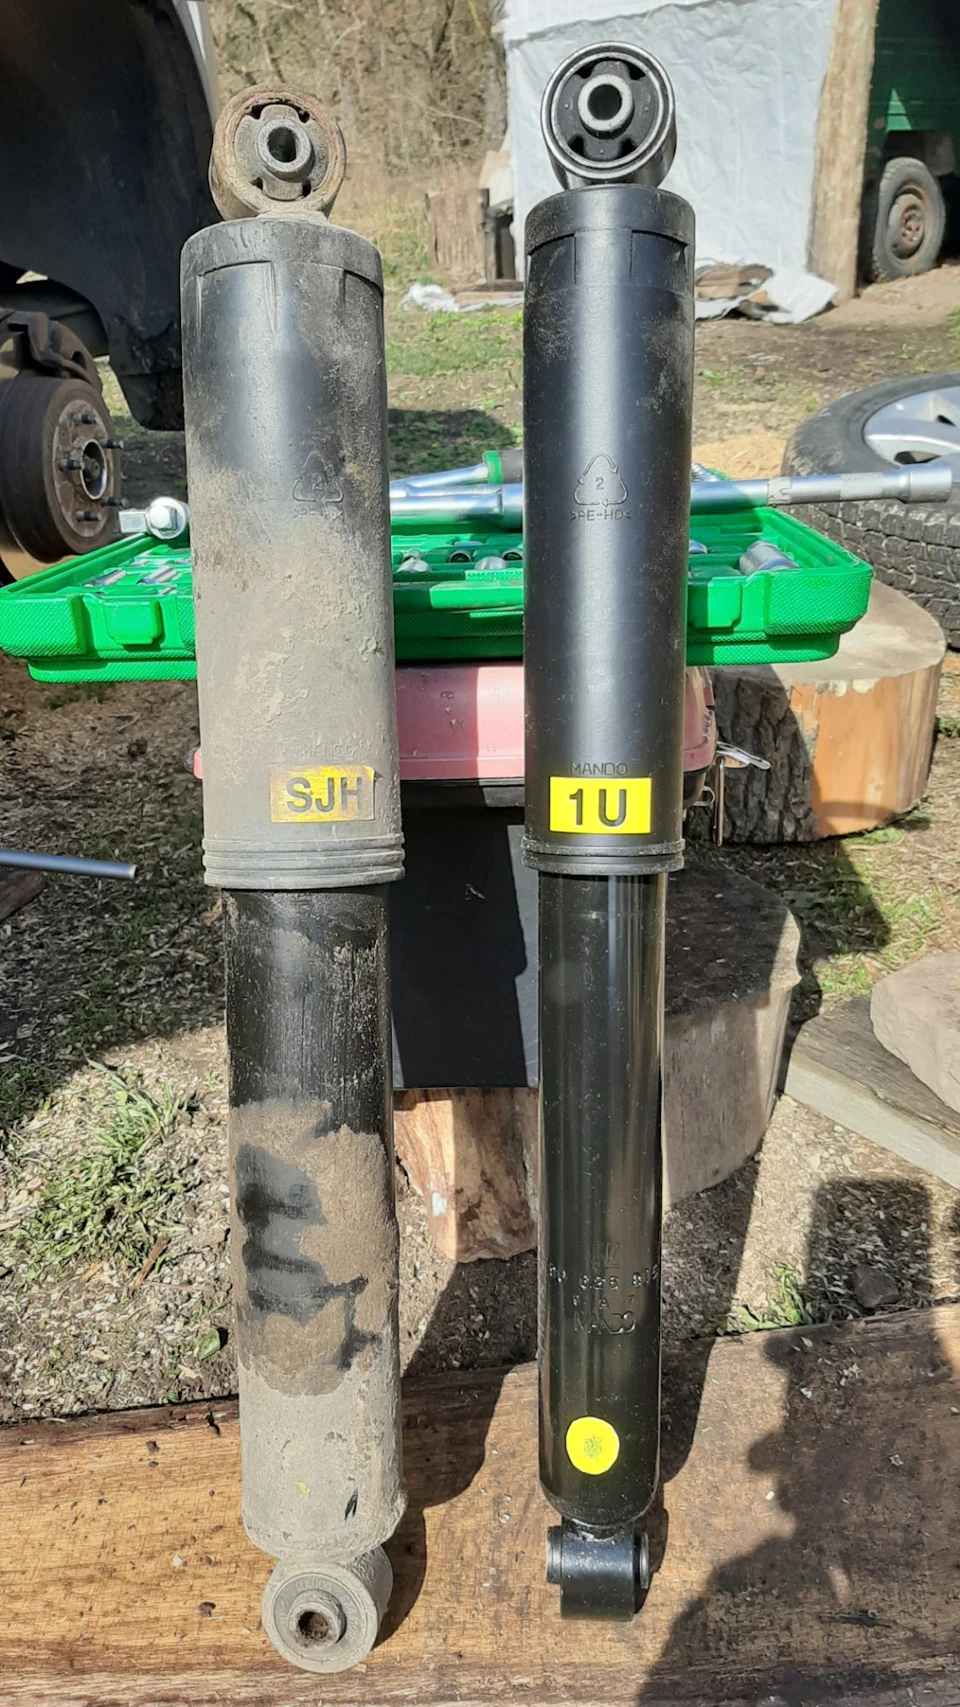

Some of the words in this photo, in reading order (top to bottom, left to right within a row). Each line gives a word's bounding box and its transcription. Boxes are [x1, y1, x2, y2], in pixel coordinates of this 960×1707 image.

[595, 476, 605, 491] 2
[570, 762, 628, 776] MANDO
[286, 776, 363, 813] SJH
